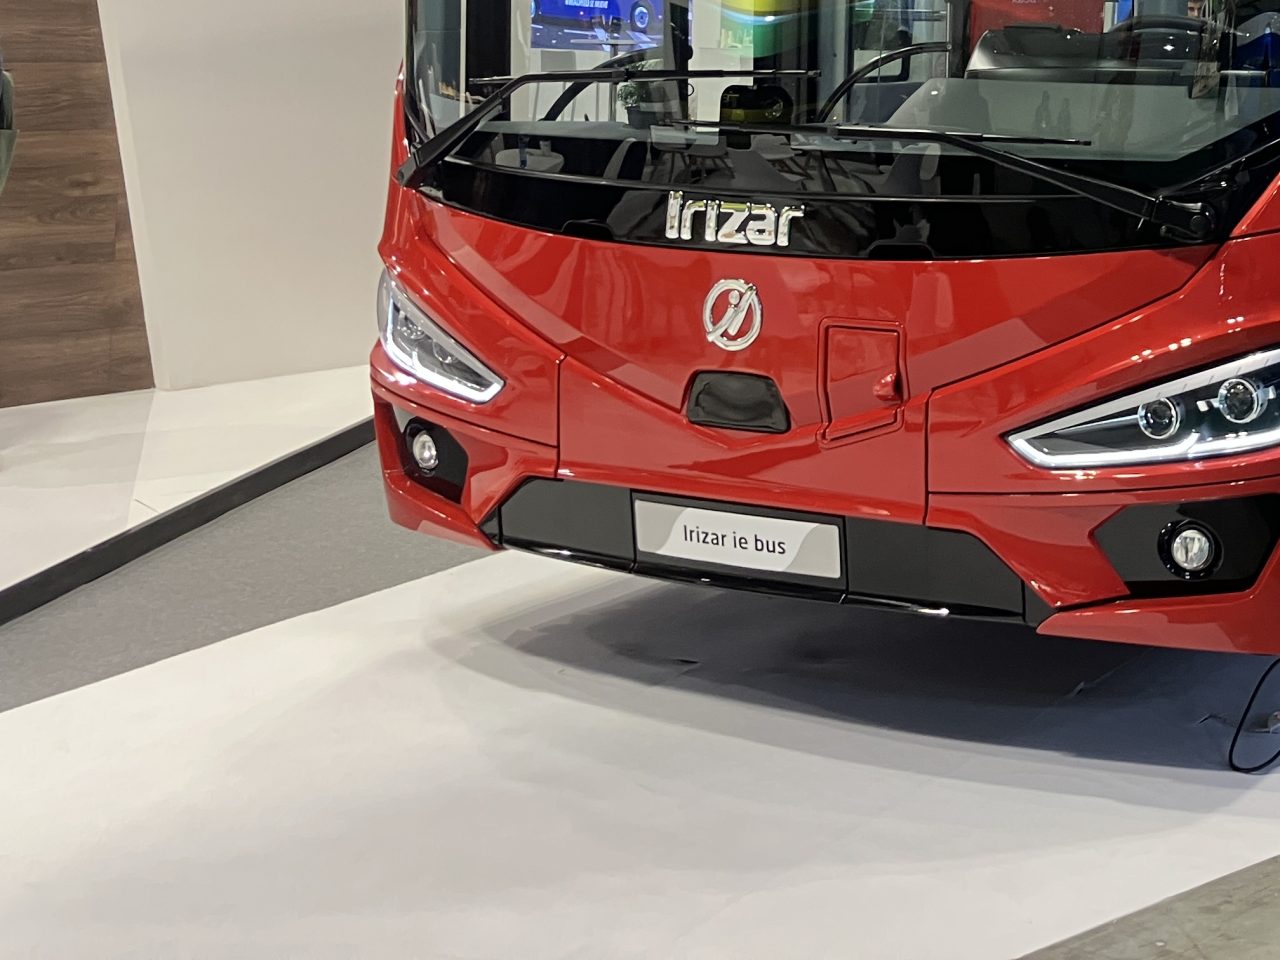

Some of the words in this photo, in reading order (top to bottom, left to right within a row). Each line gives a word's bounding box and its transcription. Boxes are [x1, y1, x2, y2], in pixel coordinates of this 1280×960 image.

[665, 190, 804, 247] Irizar
[683, 523, 727, 548] Irizar
[732, 530, 748, 550] ie
[754, 533, 786, 555] bus
